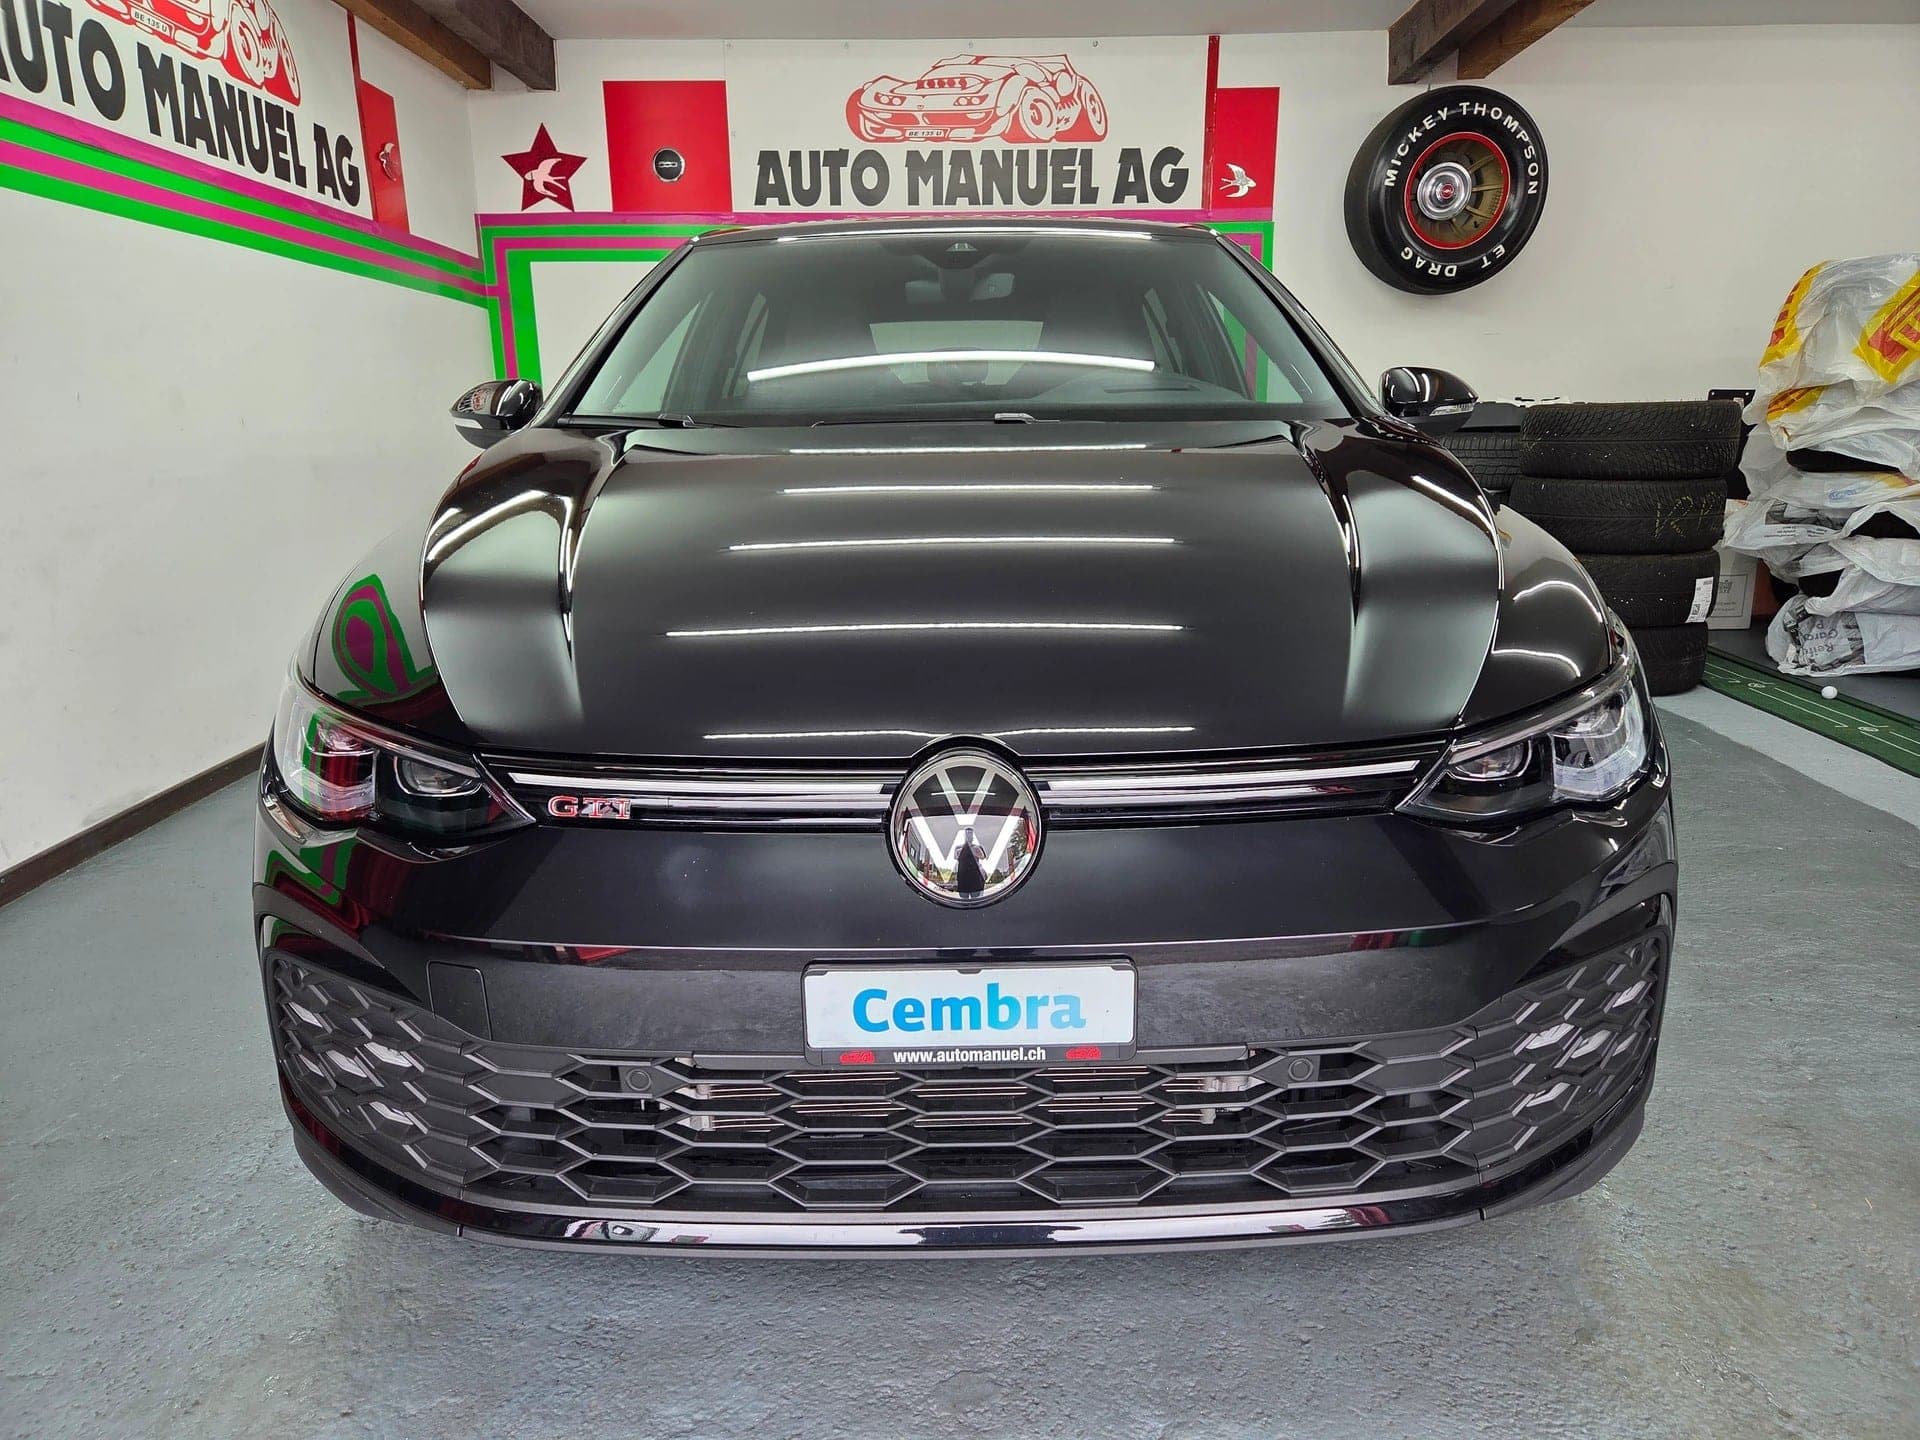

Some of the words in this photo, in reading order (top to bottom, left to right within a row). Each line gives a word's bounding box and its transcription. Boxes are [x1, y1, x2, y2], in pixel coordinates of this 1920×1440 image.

[0, 0, 126, 121] UTO
[137, 41, 307, 189] MANUEL
[313, 122, 361, 207] AG
[1384, 106, 1448, 187] MICKEY
[1458, 102, 1539, 195] THOMPSON
[754, 148, 890, 206] AUTO
[906, 148, 1100, 206] MANUEL
[1111, 146, 1189, 205] AG
[1401, 246, 1458, 277] DRAG
[1480, 244, 1506, 269] ET
[547, 795, 631, 820] GTI
[852, 982, 1087, 1033] Cembra
[893, 1046, 1046, 1064] www.automanuel.ch
